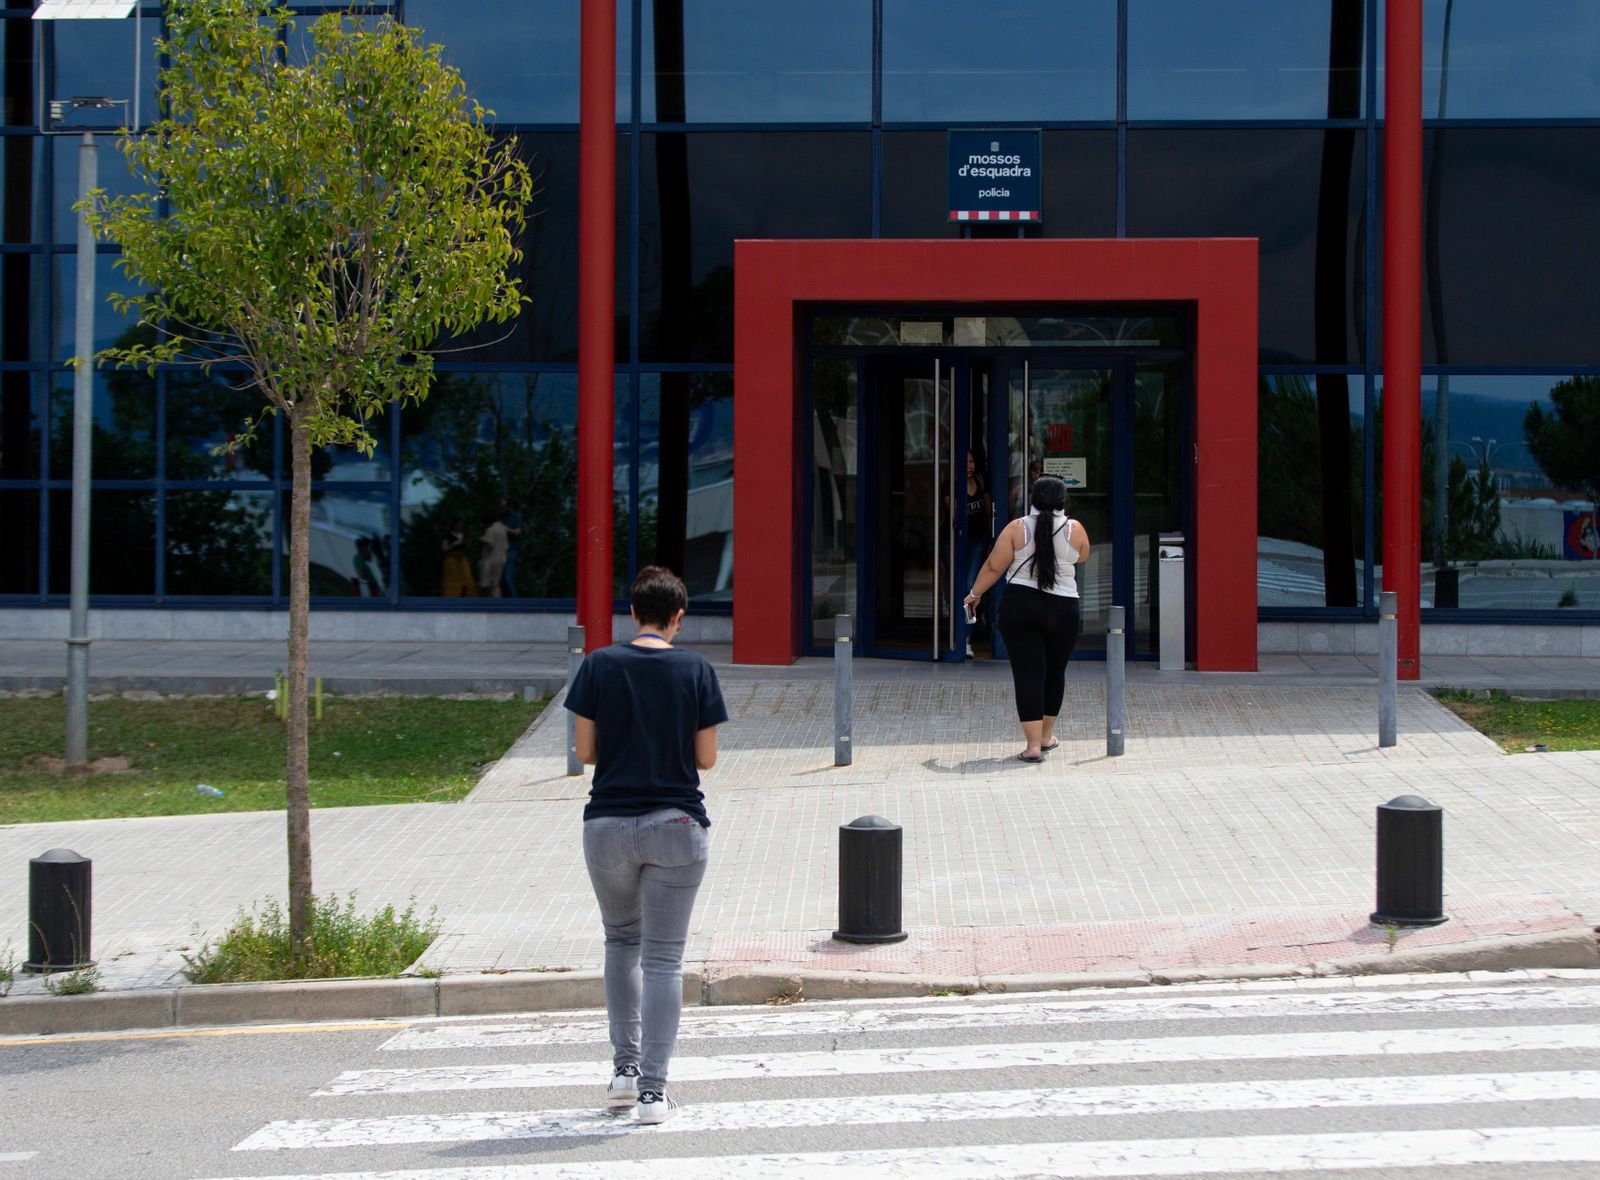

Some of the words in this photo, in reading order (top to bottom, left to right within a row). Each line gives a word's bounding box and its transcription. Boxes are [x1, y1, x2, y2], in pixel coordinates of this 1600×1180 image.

[968, 154, 1021, 165] mossos
[958, 165, 1031, 179] d'esquadra
[978, 187, 1010, 199] policia
